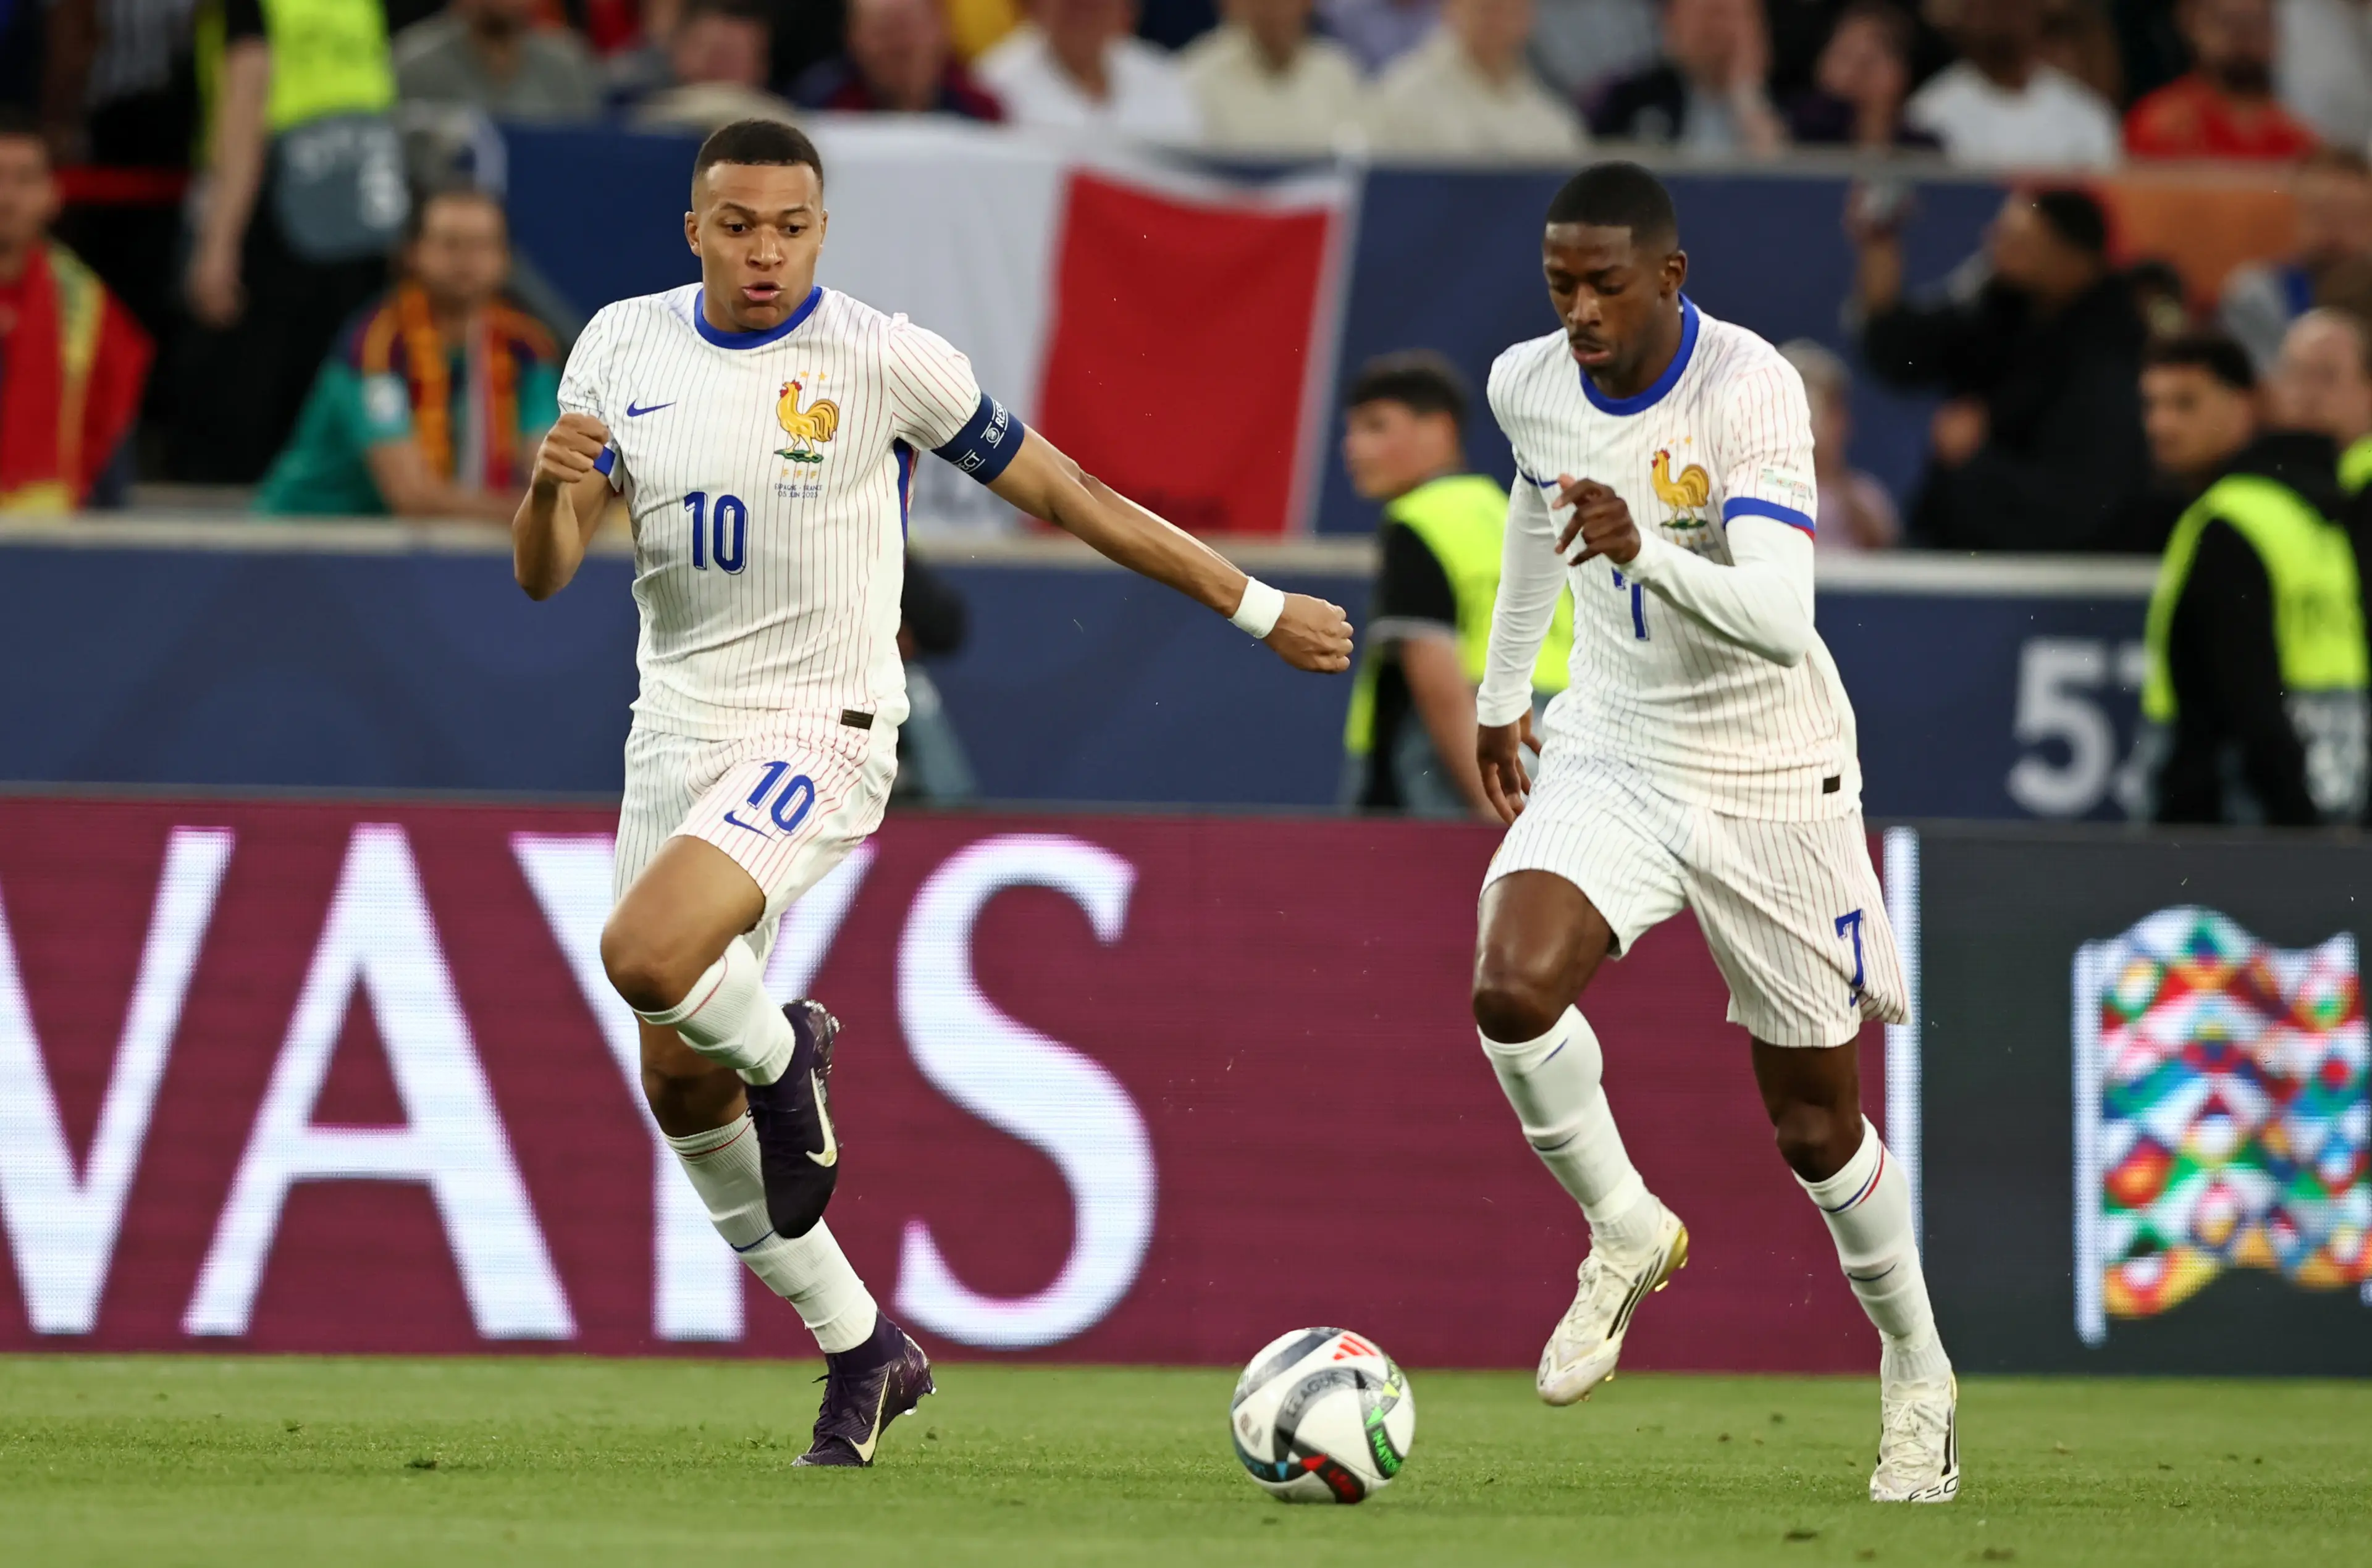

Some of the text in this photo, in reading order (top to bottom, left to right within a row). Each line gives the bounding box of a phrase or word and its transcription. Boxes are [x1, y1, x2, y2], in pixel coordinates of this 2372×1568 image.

[684, 491, 748, 575] 10
[746, 760, 815, 836] 10
[1835, 908, 1864, 989] 7
